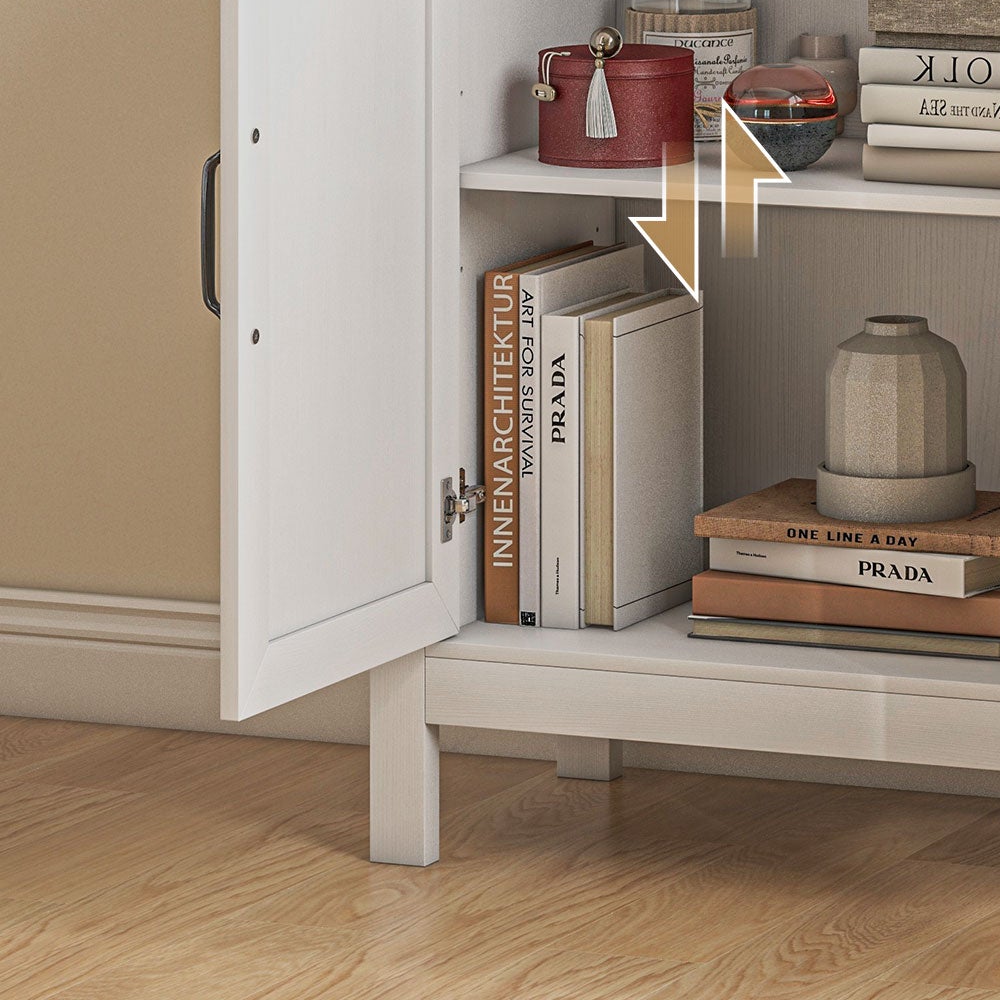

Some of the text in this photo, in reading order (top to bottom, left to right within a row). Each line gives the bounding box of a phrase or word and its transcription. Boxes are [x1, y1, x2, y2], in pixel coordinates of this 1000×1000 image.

[493, 274, 513, 567] INNENARCHITEKTUR
[522, 289, 534, 478] ART FOR SURVIVAL
[551, 354, 566, 444] PRADA
[787, 528, 918, 547] ONE LINE A DAY
[859, 560, 934, 584] PRADA
